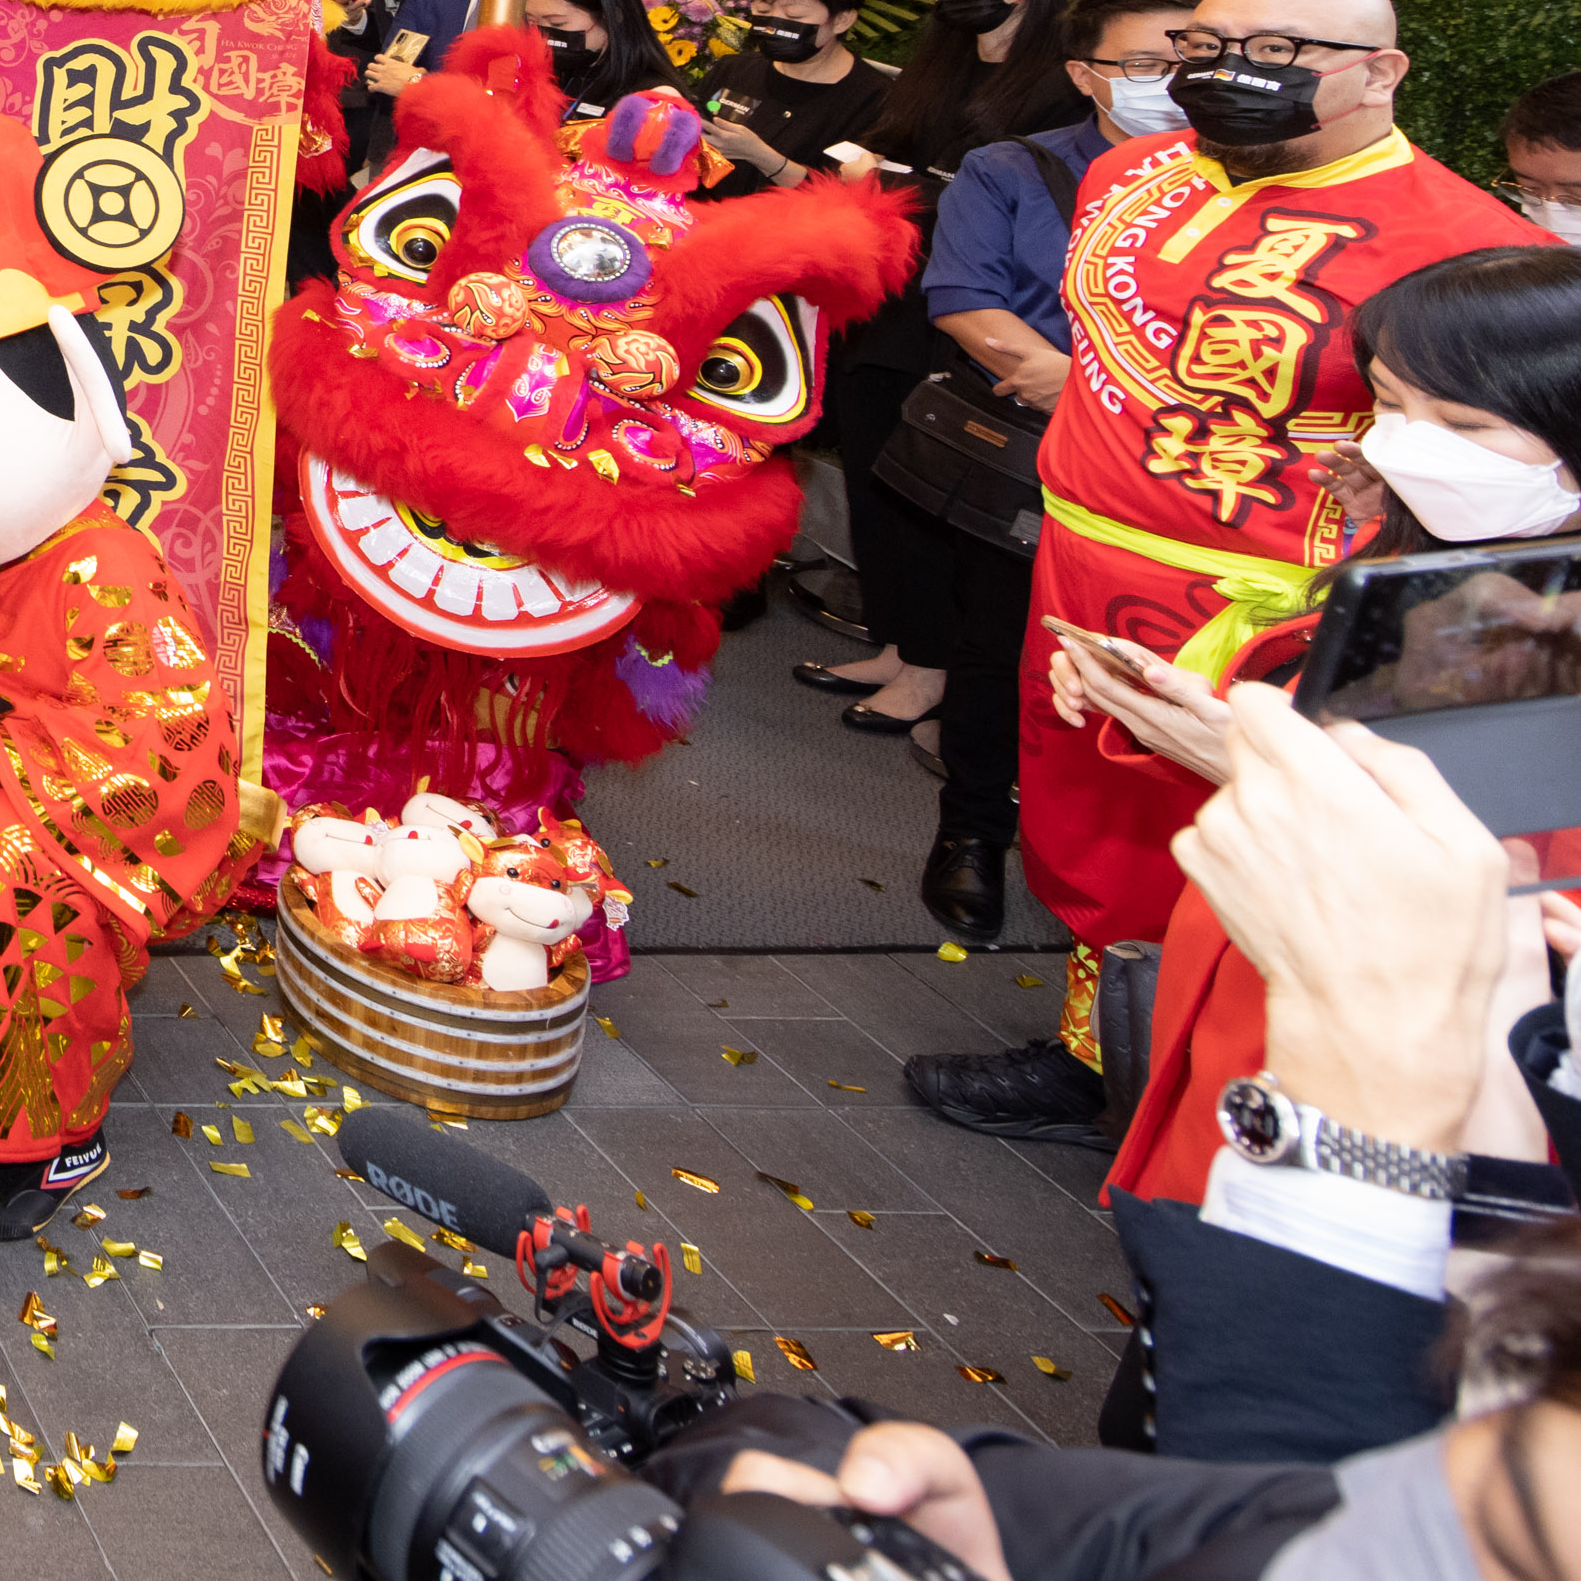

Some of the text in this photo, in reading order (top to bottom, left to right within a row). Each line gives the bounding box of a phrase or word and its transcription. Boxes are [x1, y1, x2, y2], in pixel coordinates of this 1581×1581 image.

[1105, 255, 1179, 350] KONG
[1144, 215, 1357, 523] 夏國璋
